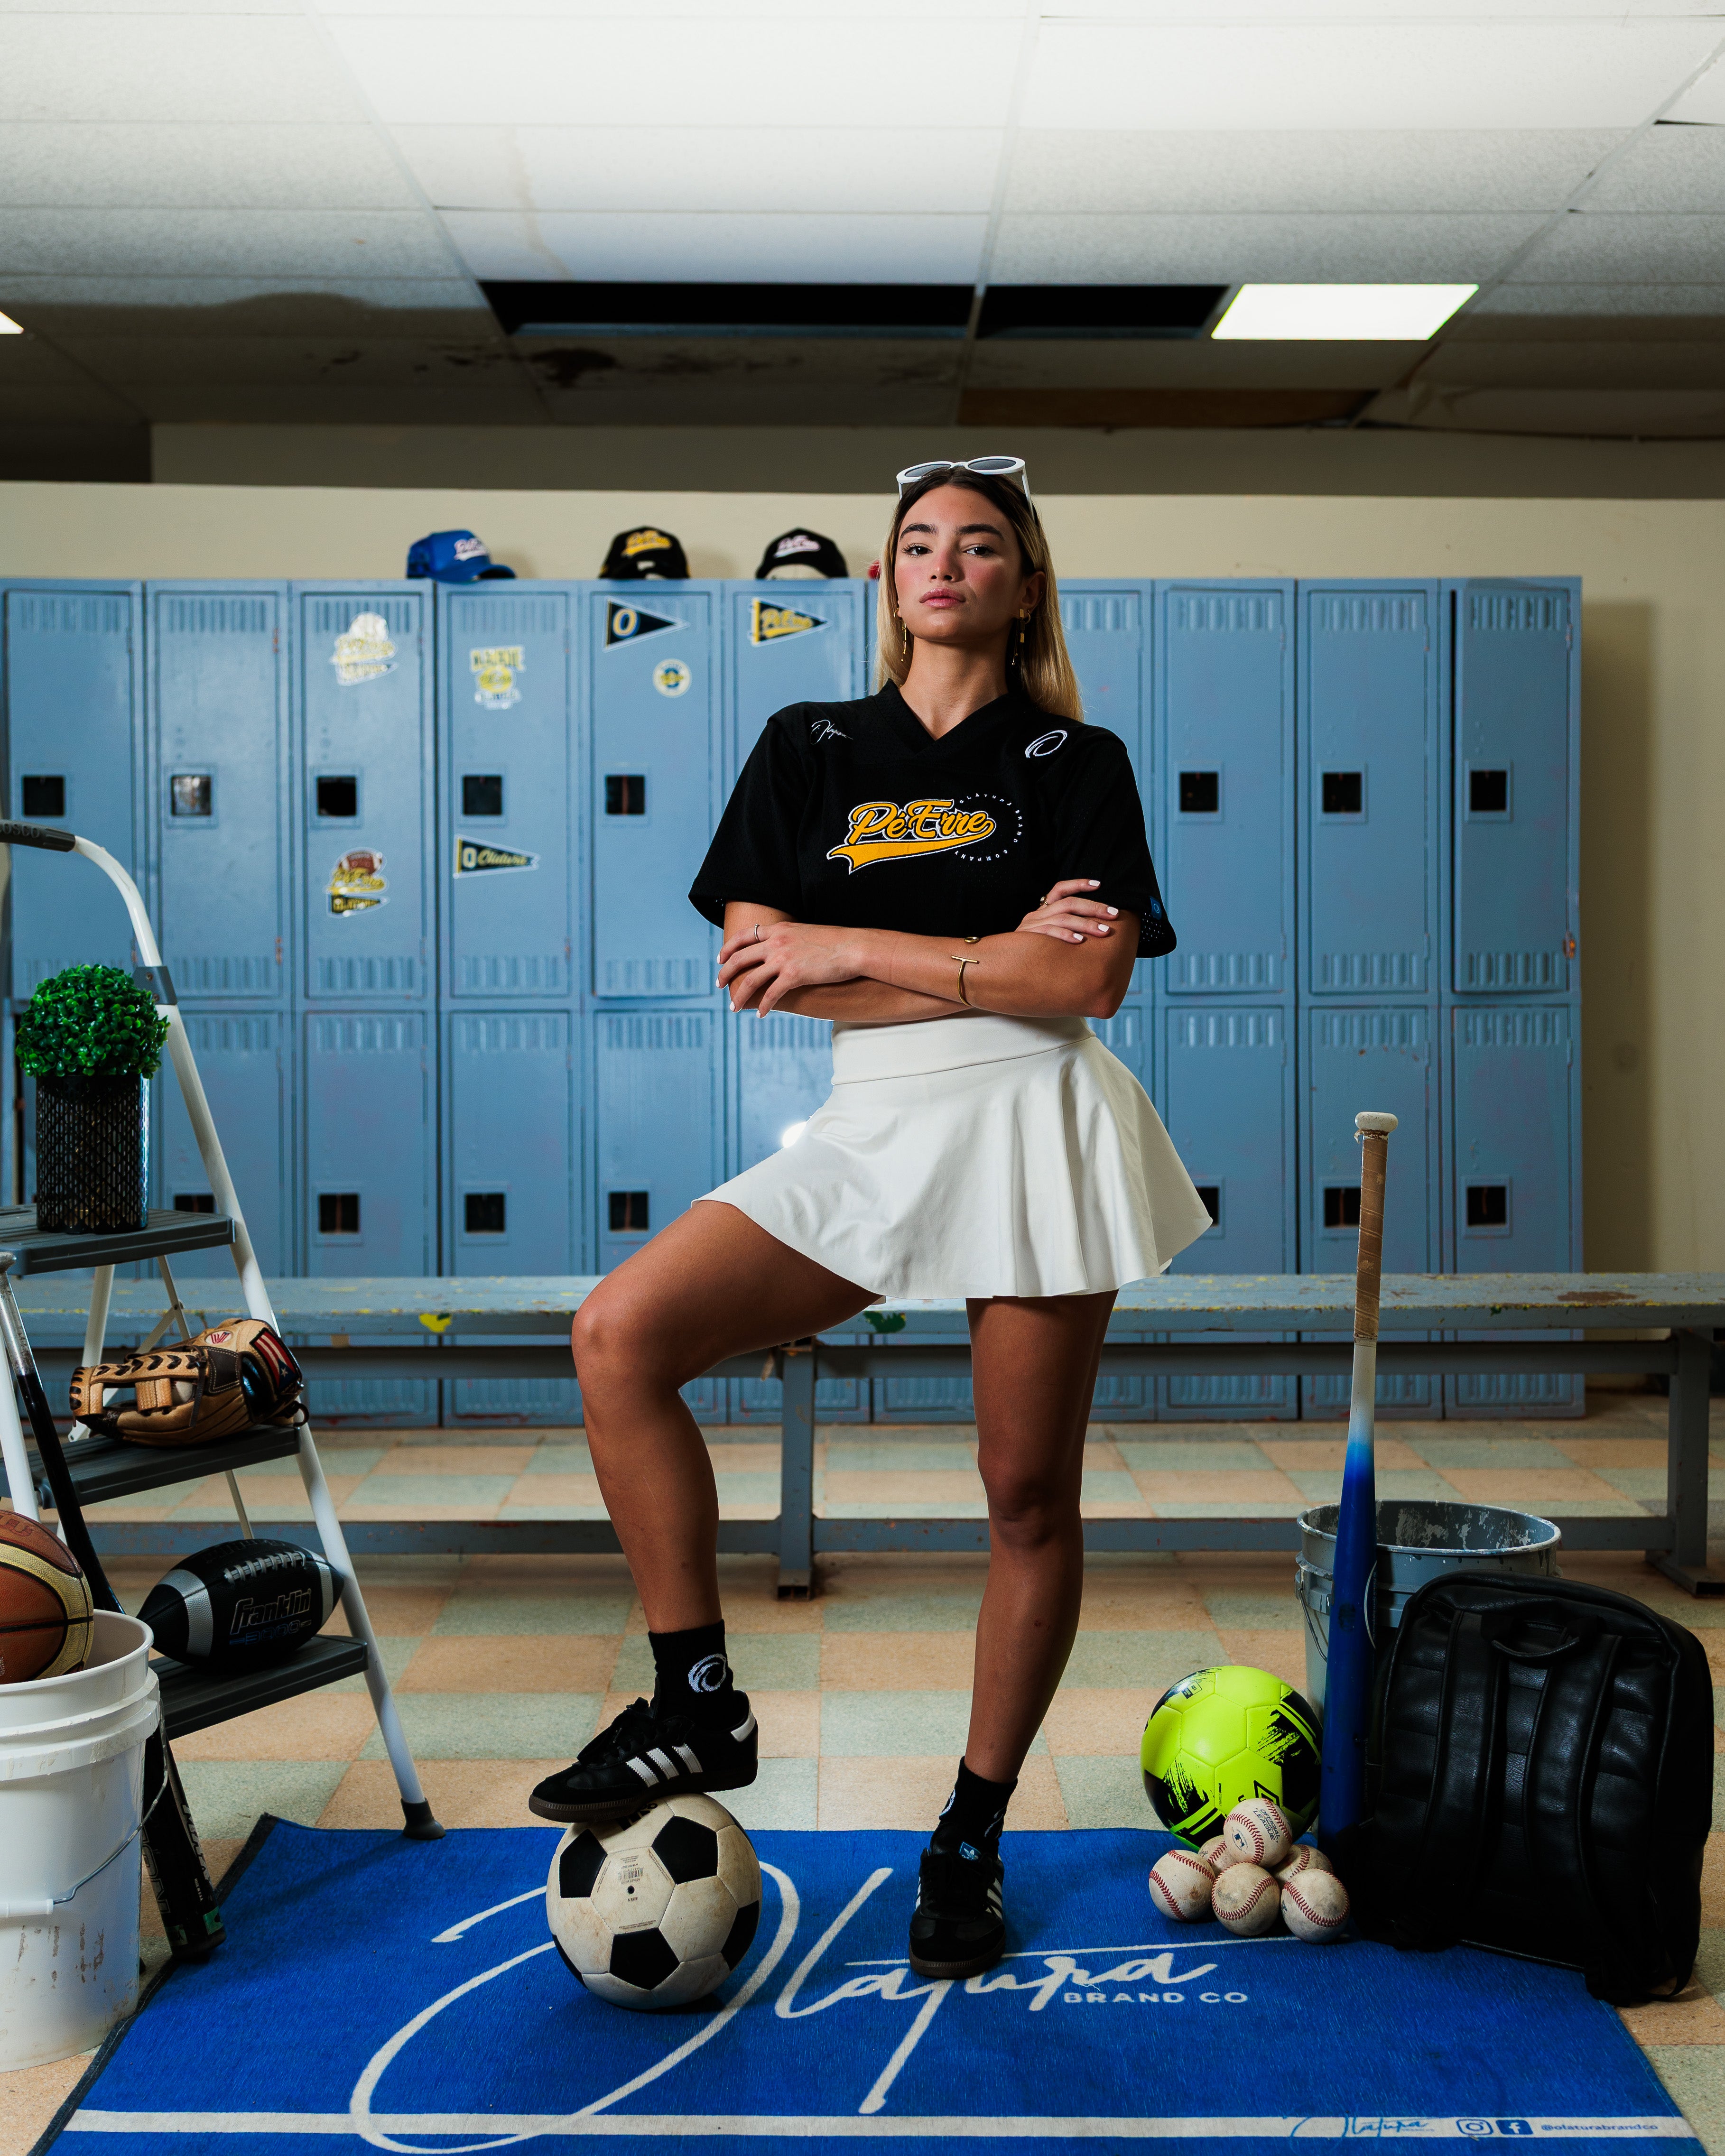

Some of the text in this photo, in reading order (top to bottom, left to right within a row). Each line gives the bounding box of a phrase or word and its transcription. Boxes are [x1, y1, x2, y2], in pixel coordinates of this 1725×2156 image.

[612, 608, 640, 639] O
[0, 823, 40, 839] OSCO
[1013, 810, 1023, 843] BRAND
[955, 850, 1008, 861] COMPANY
[230, 1588, 312, 1636] Franklin
[1252, 1810, 1275, 1841] LEAGUE
[1260, 1809, 1281, 1840] OFFICIAL
[1063, 1992, 1248, 2003] BRAND CO
[1541, 2123, 1659, 2132] @olaturabrandco
